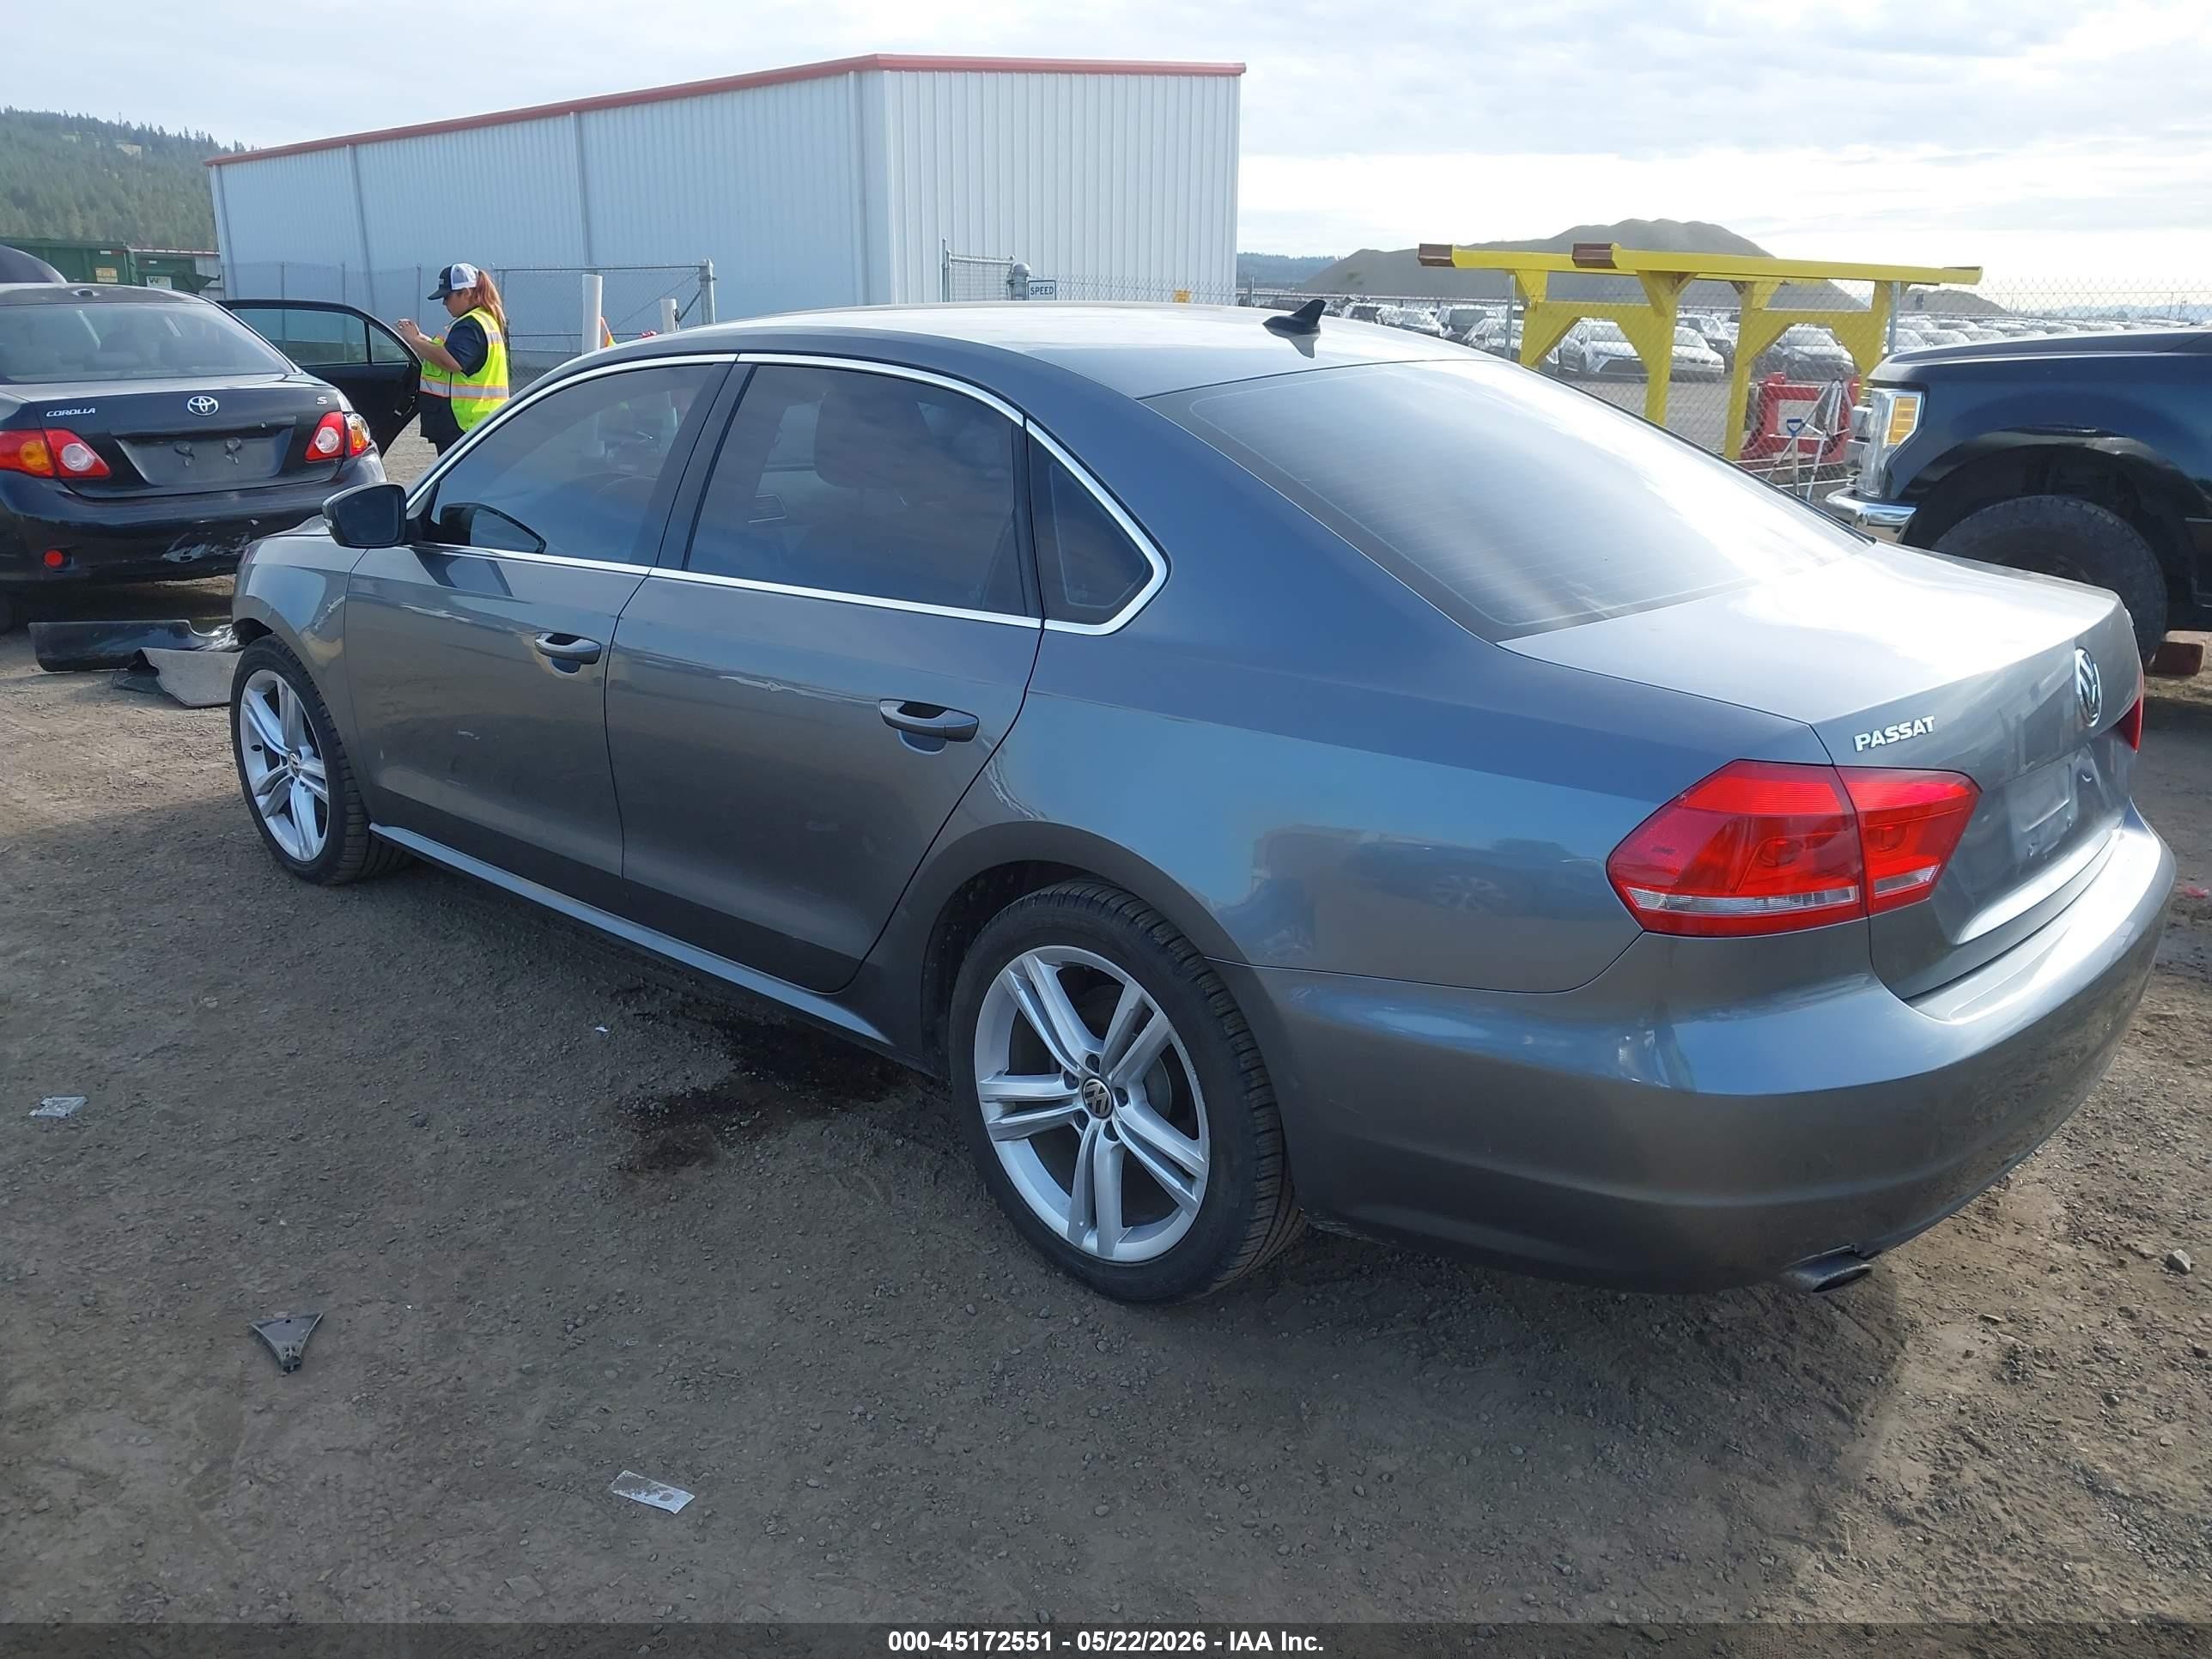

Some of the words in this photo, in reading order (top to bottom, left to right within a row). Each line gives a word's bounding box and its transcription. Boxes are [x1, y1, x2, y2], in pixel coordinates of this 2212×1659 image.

[1030, 286, 1054, 295] SPEED
[316, 396, 328, 404] S
[46, 408, 96, 417] COROLLA
[1854, 715, 1935, 751] PASSAT
